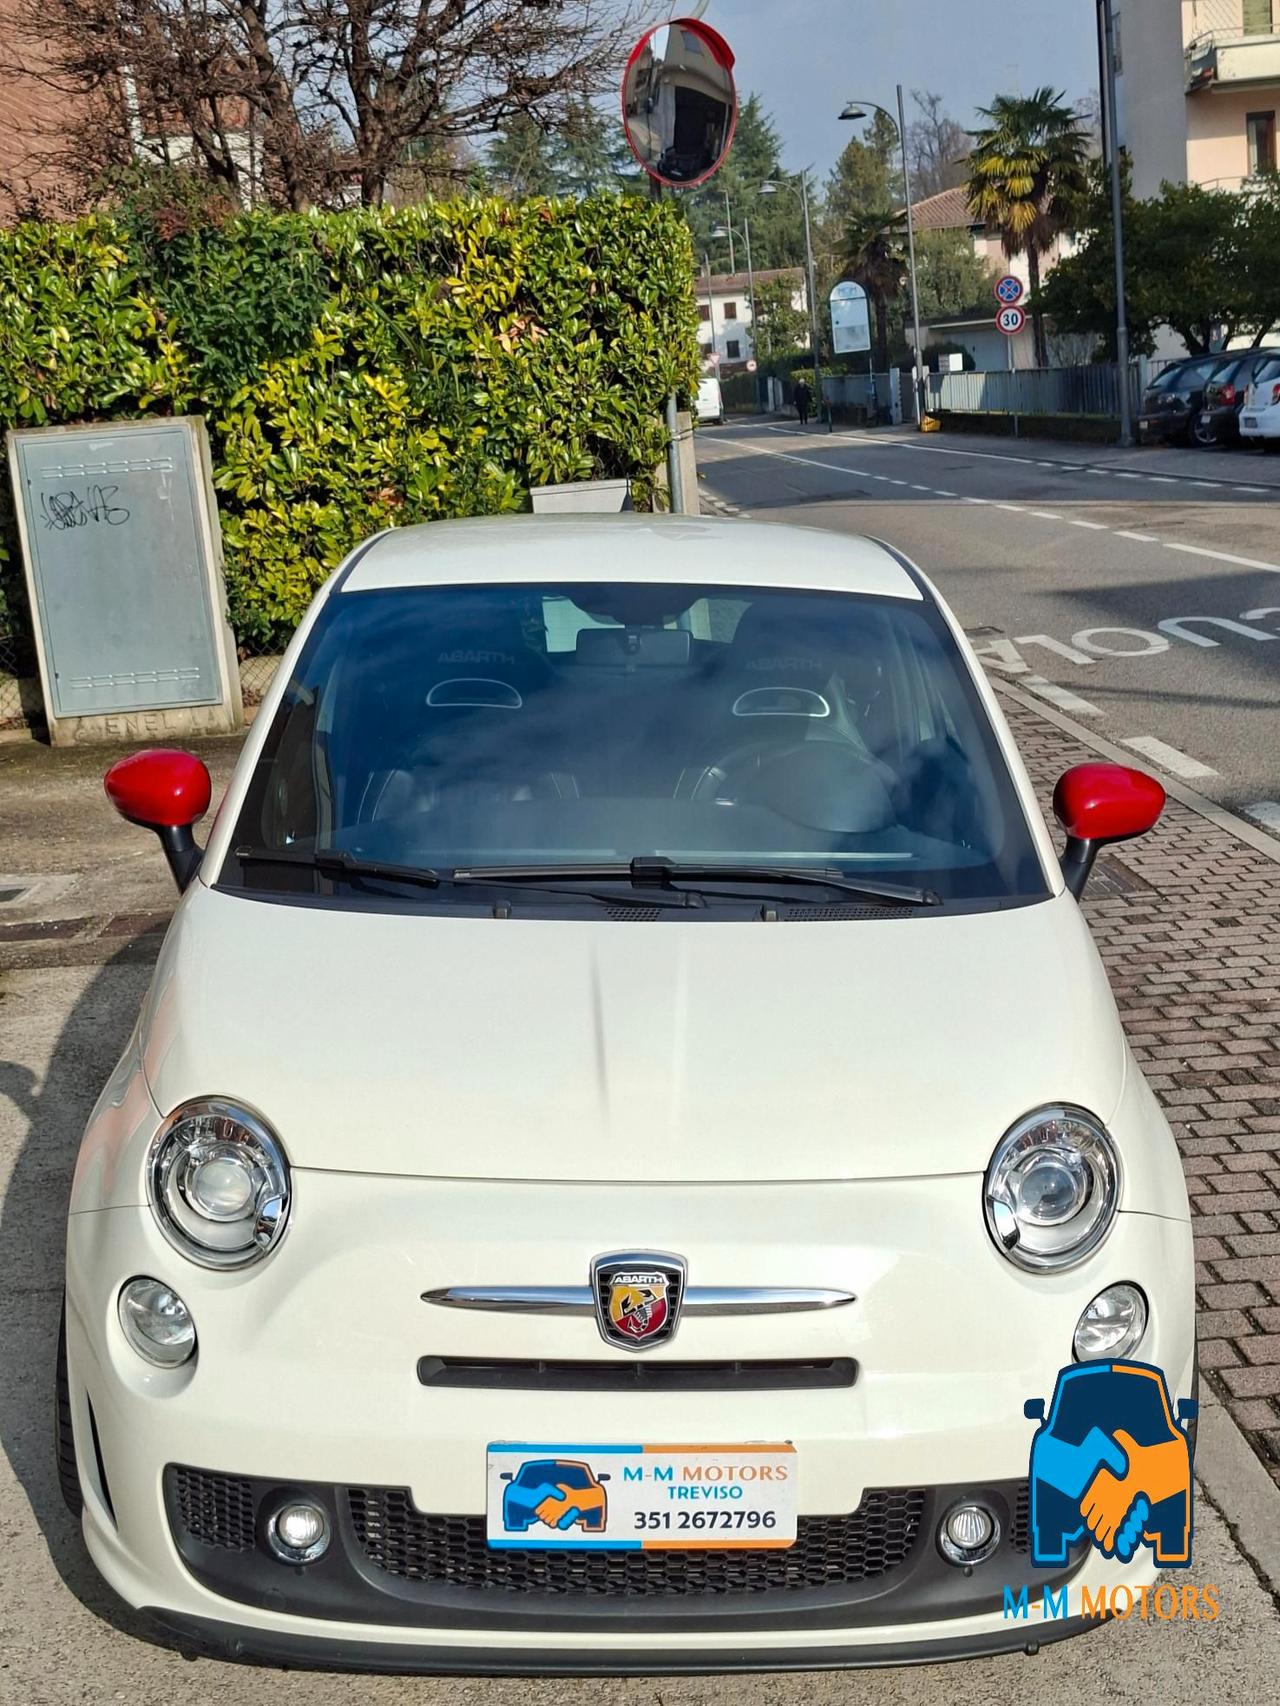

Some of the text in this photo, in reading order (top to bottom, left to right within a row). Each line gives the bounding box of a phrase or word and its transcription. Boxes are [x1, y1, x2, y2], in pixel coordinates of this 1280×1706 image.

[1002, 312, 1019, 327] 30
[614, 1275, 663, 1283] ABARTH
[623, 1465, 788, 1482] M-M MOTORS
[668, 1486, 743, 1500] TREVISO
[634, 1511, 776, 1529] 351 2672796
